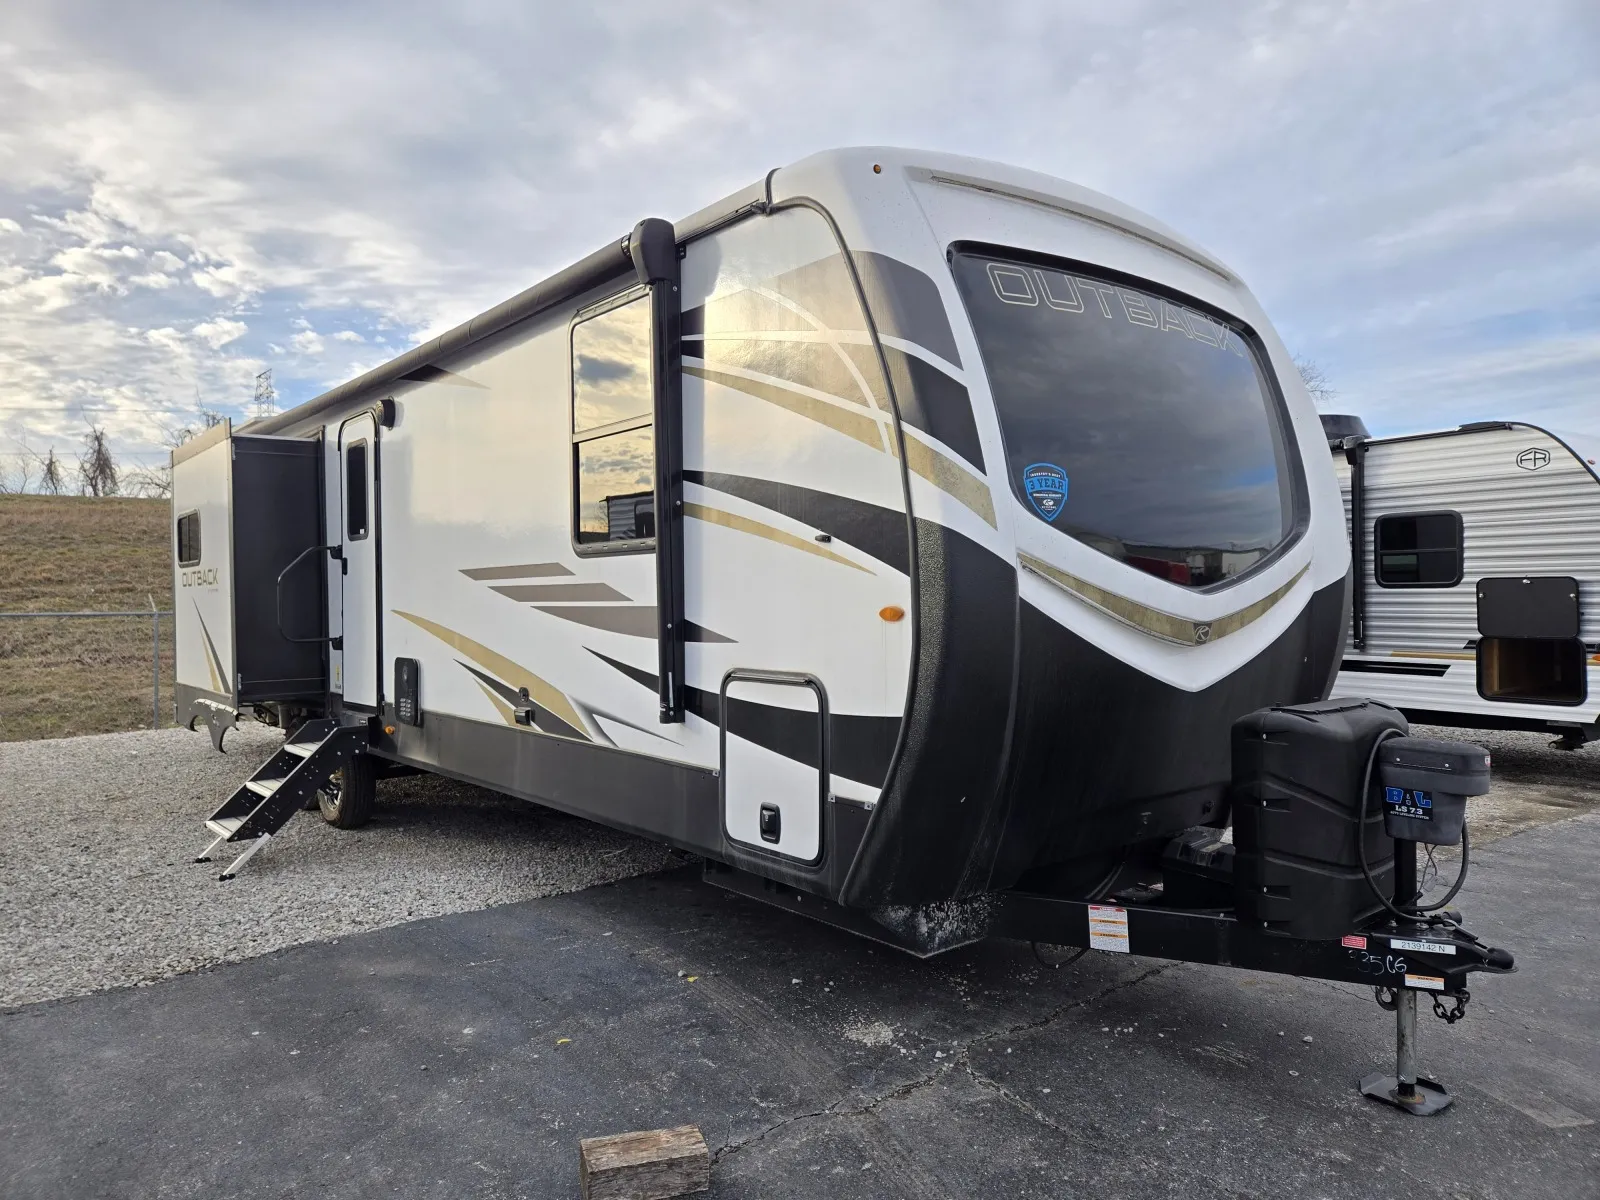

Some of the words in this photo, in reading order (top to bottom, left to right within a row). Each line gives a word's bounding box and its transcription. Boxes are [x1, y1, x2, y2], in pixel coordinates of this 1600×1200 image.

[986, 263, 1243, 357] OUTBACK
[1029, 480, 1035, 490] 3
[1037, 478, 1064, 490] YEAR
[182, 568, 218, 587] OUTBACK
[1401, 942, 1436, 952] 2139142
[1438, 945, 1446, 953] N
